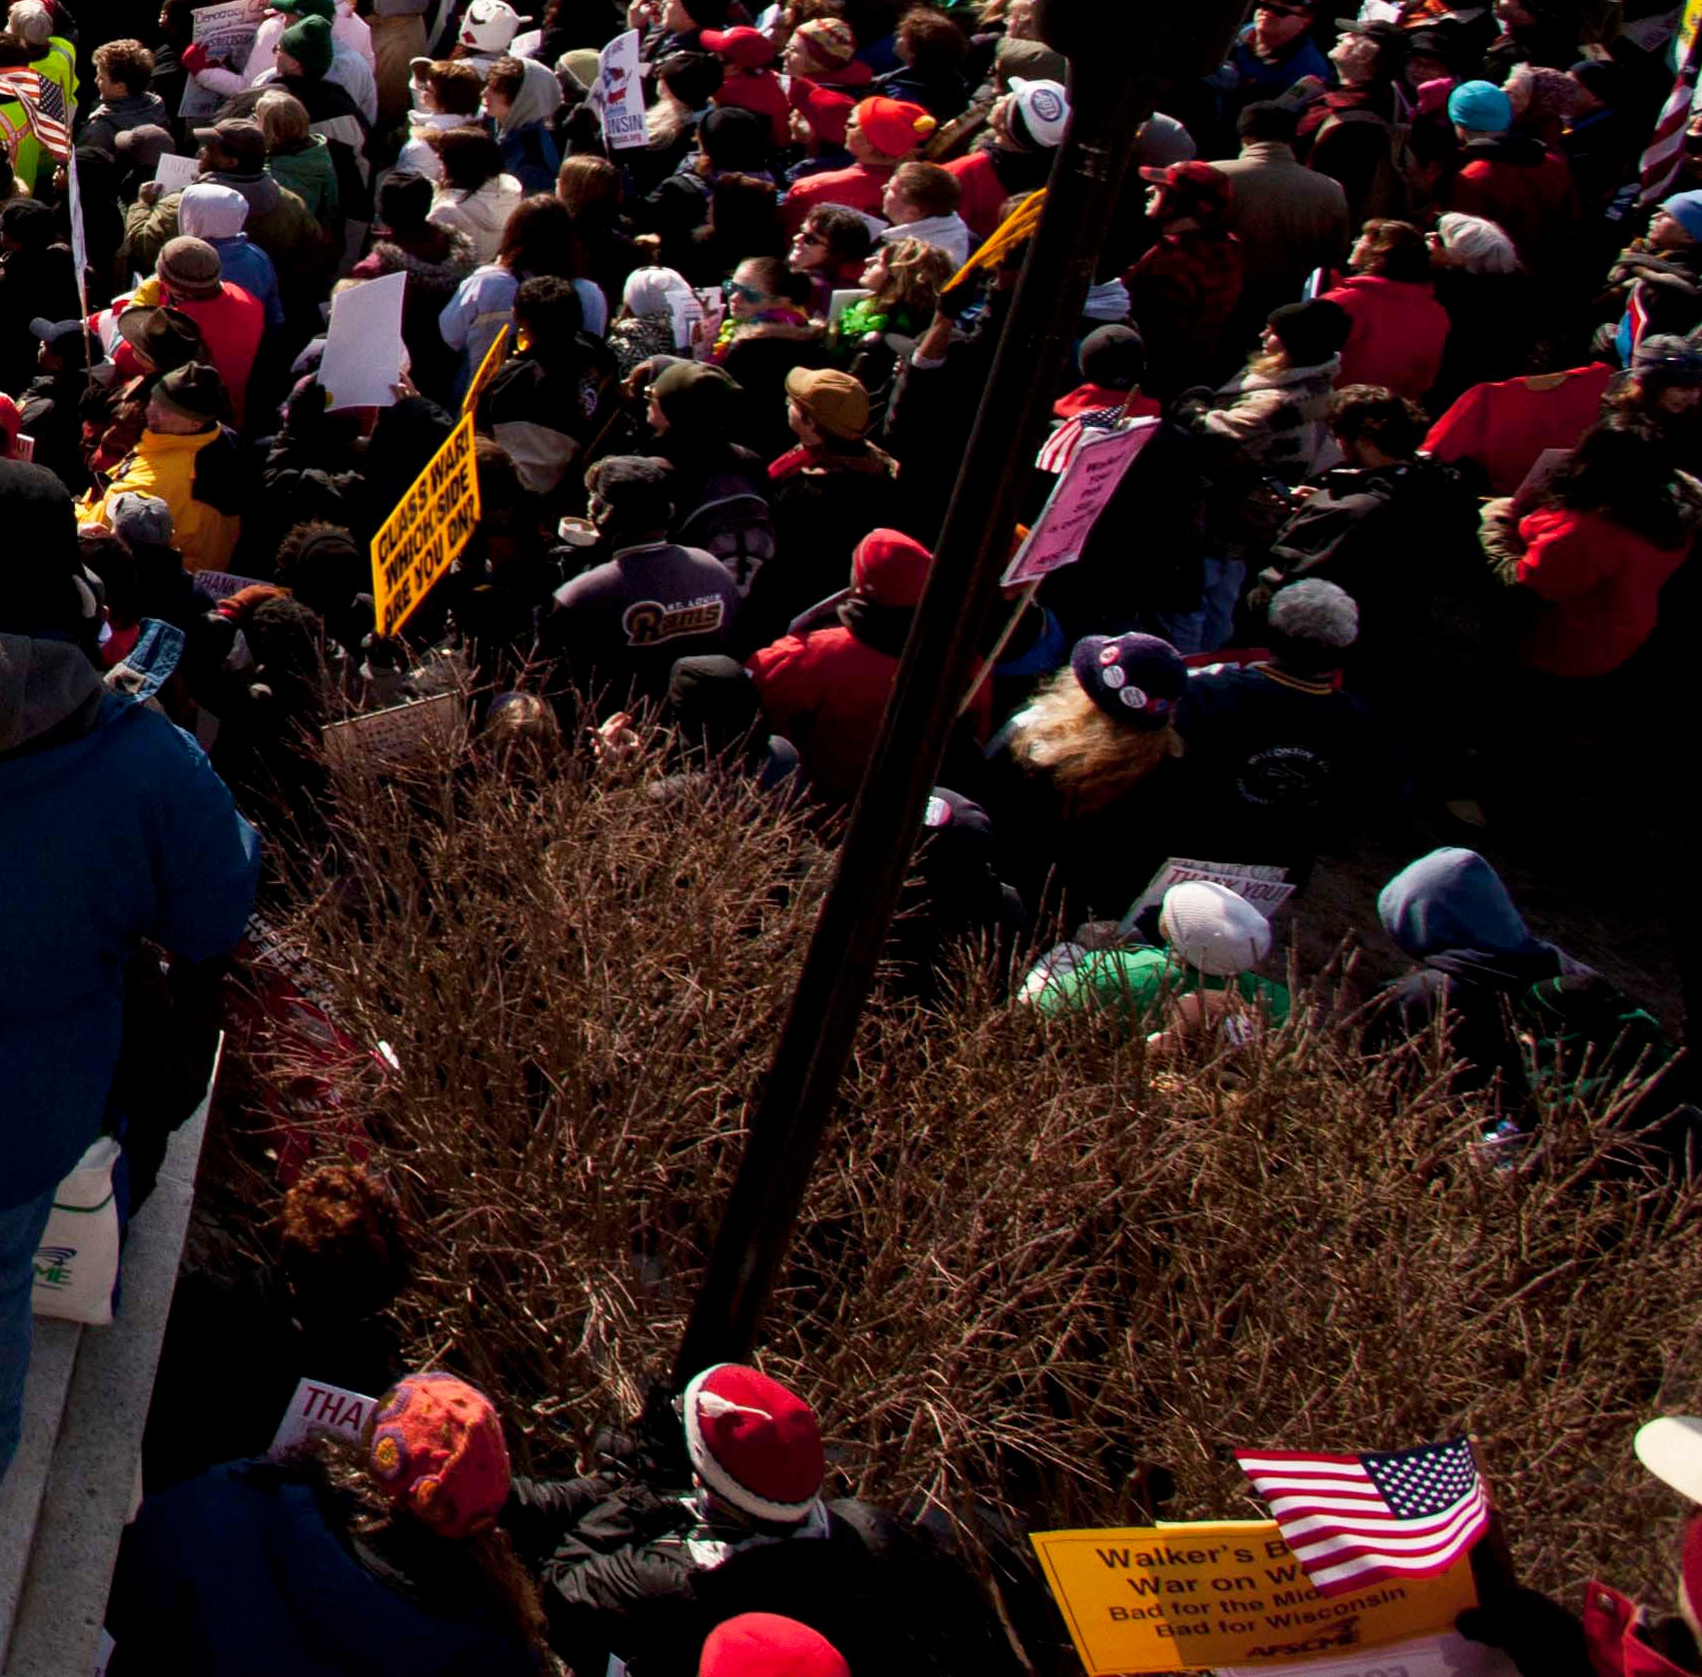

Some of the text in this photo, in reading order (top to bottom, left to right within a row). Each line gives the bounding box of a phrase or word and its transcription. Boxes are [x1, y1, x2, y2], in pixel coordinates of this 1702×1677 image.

[196, 8, 245, 25] Democracy
[379, 428, 471, 558] CLASS WAR!
[384, 461, 470, 588] WHICH SIDE
[385, 494, 476, 627] ARE YOU ON?
[621, 600, 725, 646] Rams
[1244, 883, 1293, 901] YOU!
[1096, 1542, 1254, 1570] Walker's
[1127, 1573, 1256, 1597] War on
[1109, 1604, 1164, 1622] Bad
[1172, 1599, 1212, 1617] for
[1219, 1597, 1265, 1616] the
[1154, 1585, 1406, 1639] Bad for Wisconsin
[1246, 1633, 1357, 1658] AFSCME
